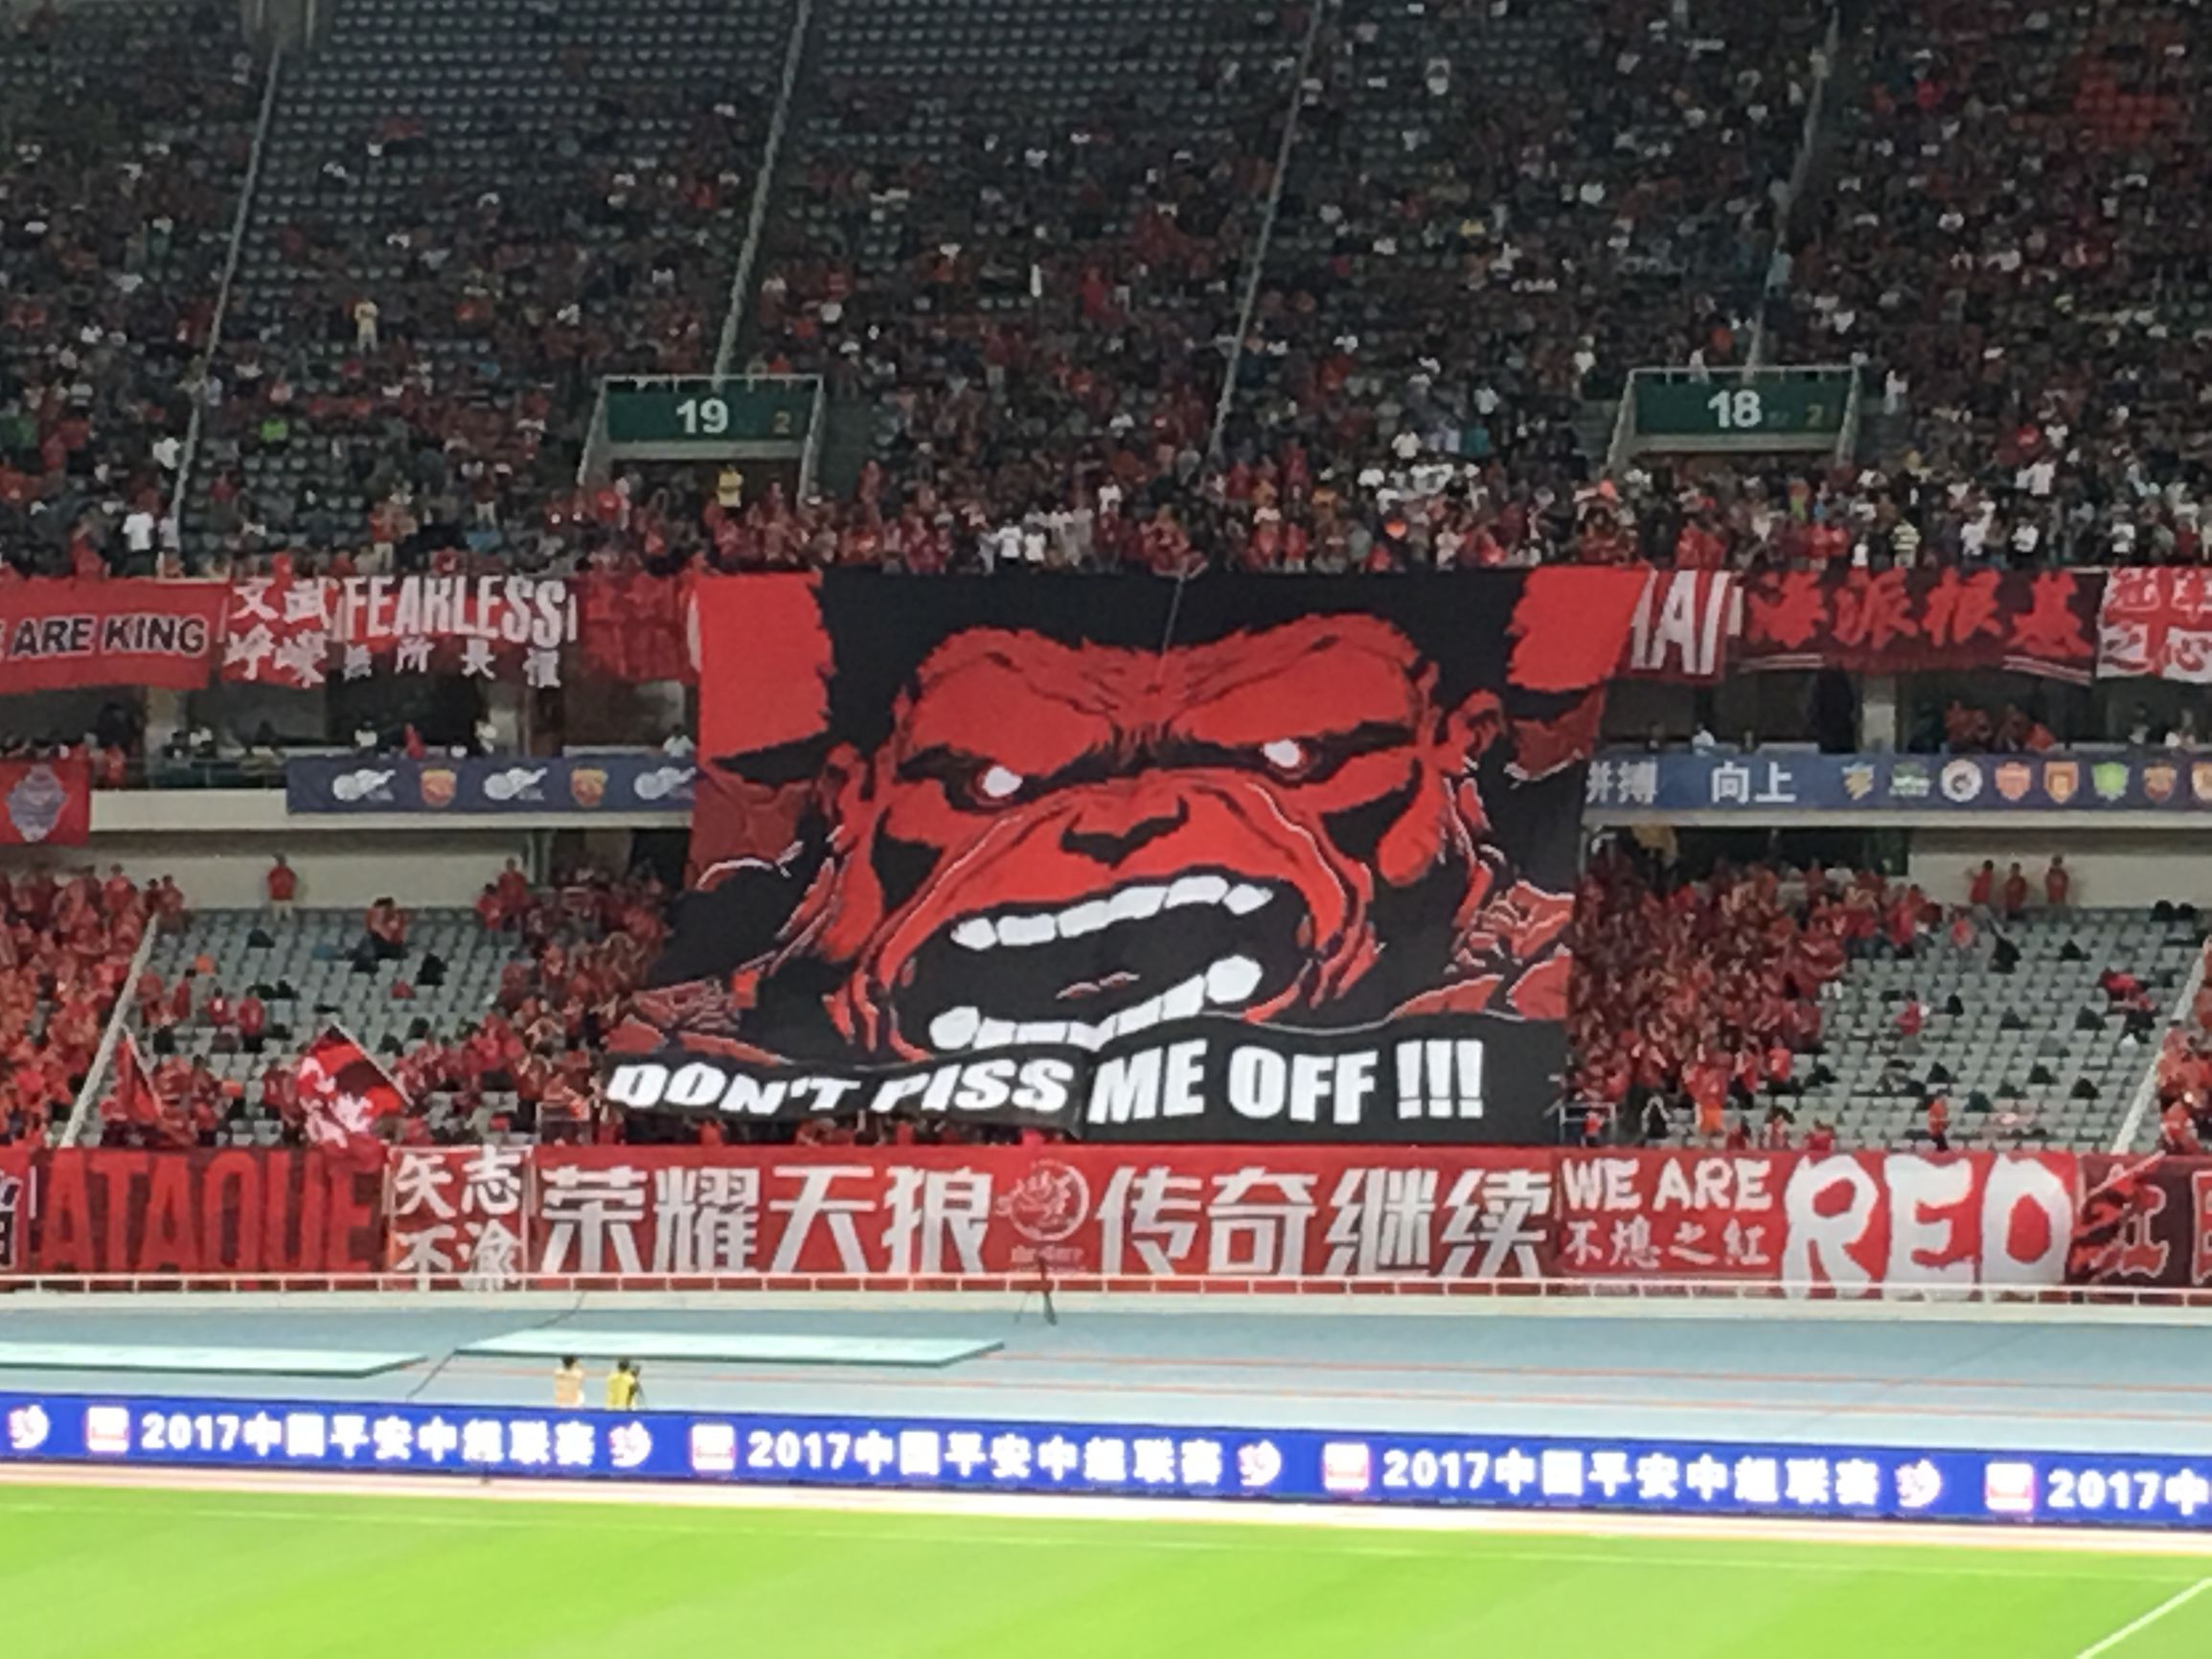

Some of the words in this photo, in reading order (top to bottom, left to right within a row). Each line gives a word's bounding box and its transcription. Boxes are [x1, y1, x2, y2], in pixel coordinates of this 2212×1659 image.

[676, 398, 729, 434] 19
[773, 409, 791, 434] 2
[1707, 388, 1763, 428] 18
[1806, 403, 1824, 427] 2
[9, 615, 95, 660] ARE
[102, 612, 209, 658] KING
[344, 574, 566, 648] FEARLESS
[1711, 760, 1798, 805] 向上
[605, 1060, 861, 1115] DON'T
[870, 1057, 1073, 1112] PISS
[1086, 1038, 1209, 1125] ME
[1227, 1045, 1380, 1125] OFF
[1395, 1038, 1485, 1120] !!!
[38, 1148, 373, 1274] ATAQUE
[394, 1146, 522, 1218] 矢志
[1561, 1156, 1642, 1212] WE
[1652, 1156, 1772, 1212] ARE
[394, 1219, 523, 1293] 不渝
[539, 1164, 993, 1274] 荣耀天狼
[1095, 1165, 1554, 1279] 传奇继续
[1781, 1152, 2073, 1301] RED
